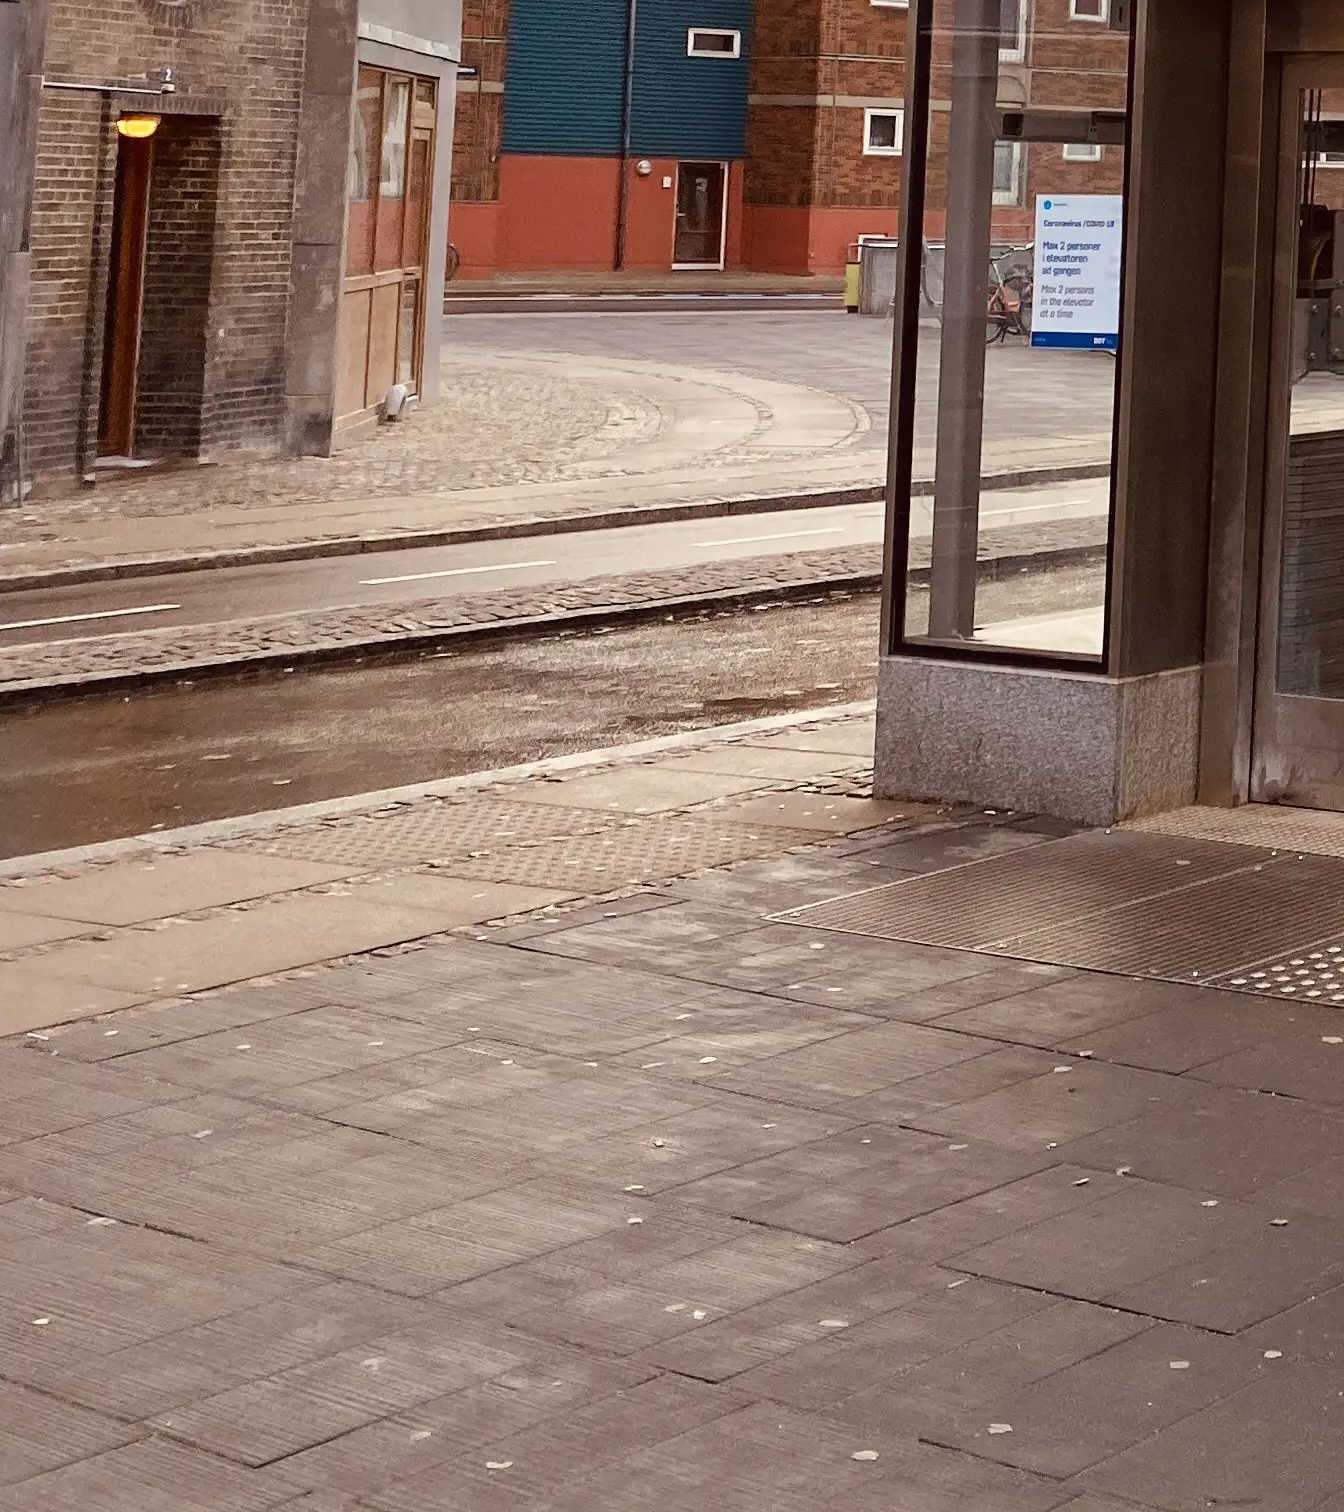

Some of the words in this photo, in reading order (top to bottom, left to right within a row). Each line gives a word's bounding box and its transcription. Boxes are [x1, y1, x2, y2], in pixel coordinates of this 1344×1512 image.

[1042, 241, 1059, 250] Max
[1060, 242, 1066, 250] 2
[1066, 242, 1102, 251] personer
[1046, 254, 1088, 263] elevatoren
[1042, 266, 1051, 275] ad
[1053, 267, 1081, 277] gangen
[1041, 285, 1057, 294] Max
[1058, 285, 1064, 294] 2
[1064, 286, 1095, 295] persons
[1040, 297, 1048, 306] in
[1050, 298, 1062, 306] the
[1063, 298, 1095, 307] elevator
[1039, 310, 1049, 319] at
[1056, 310, 1073, 319] time
